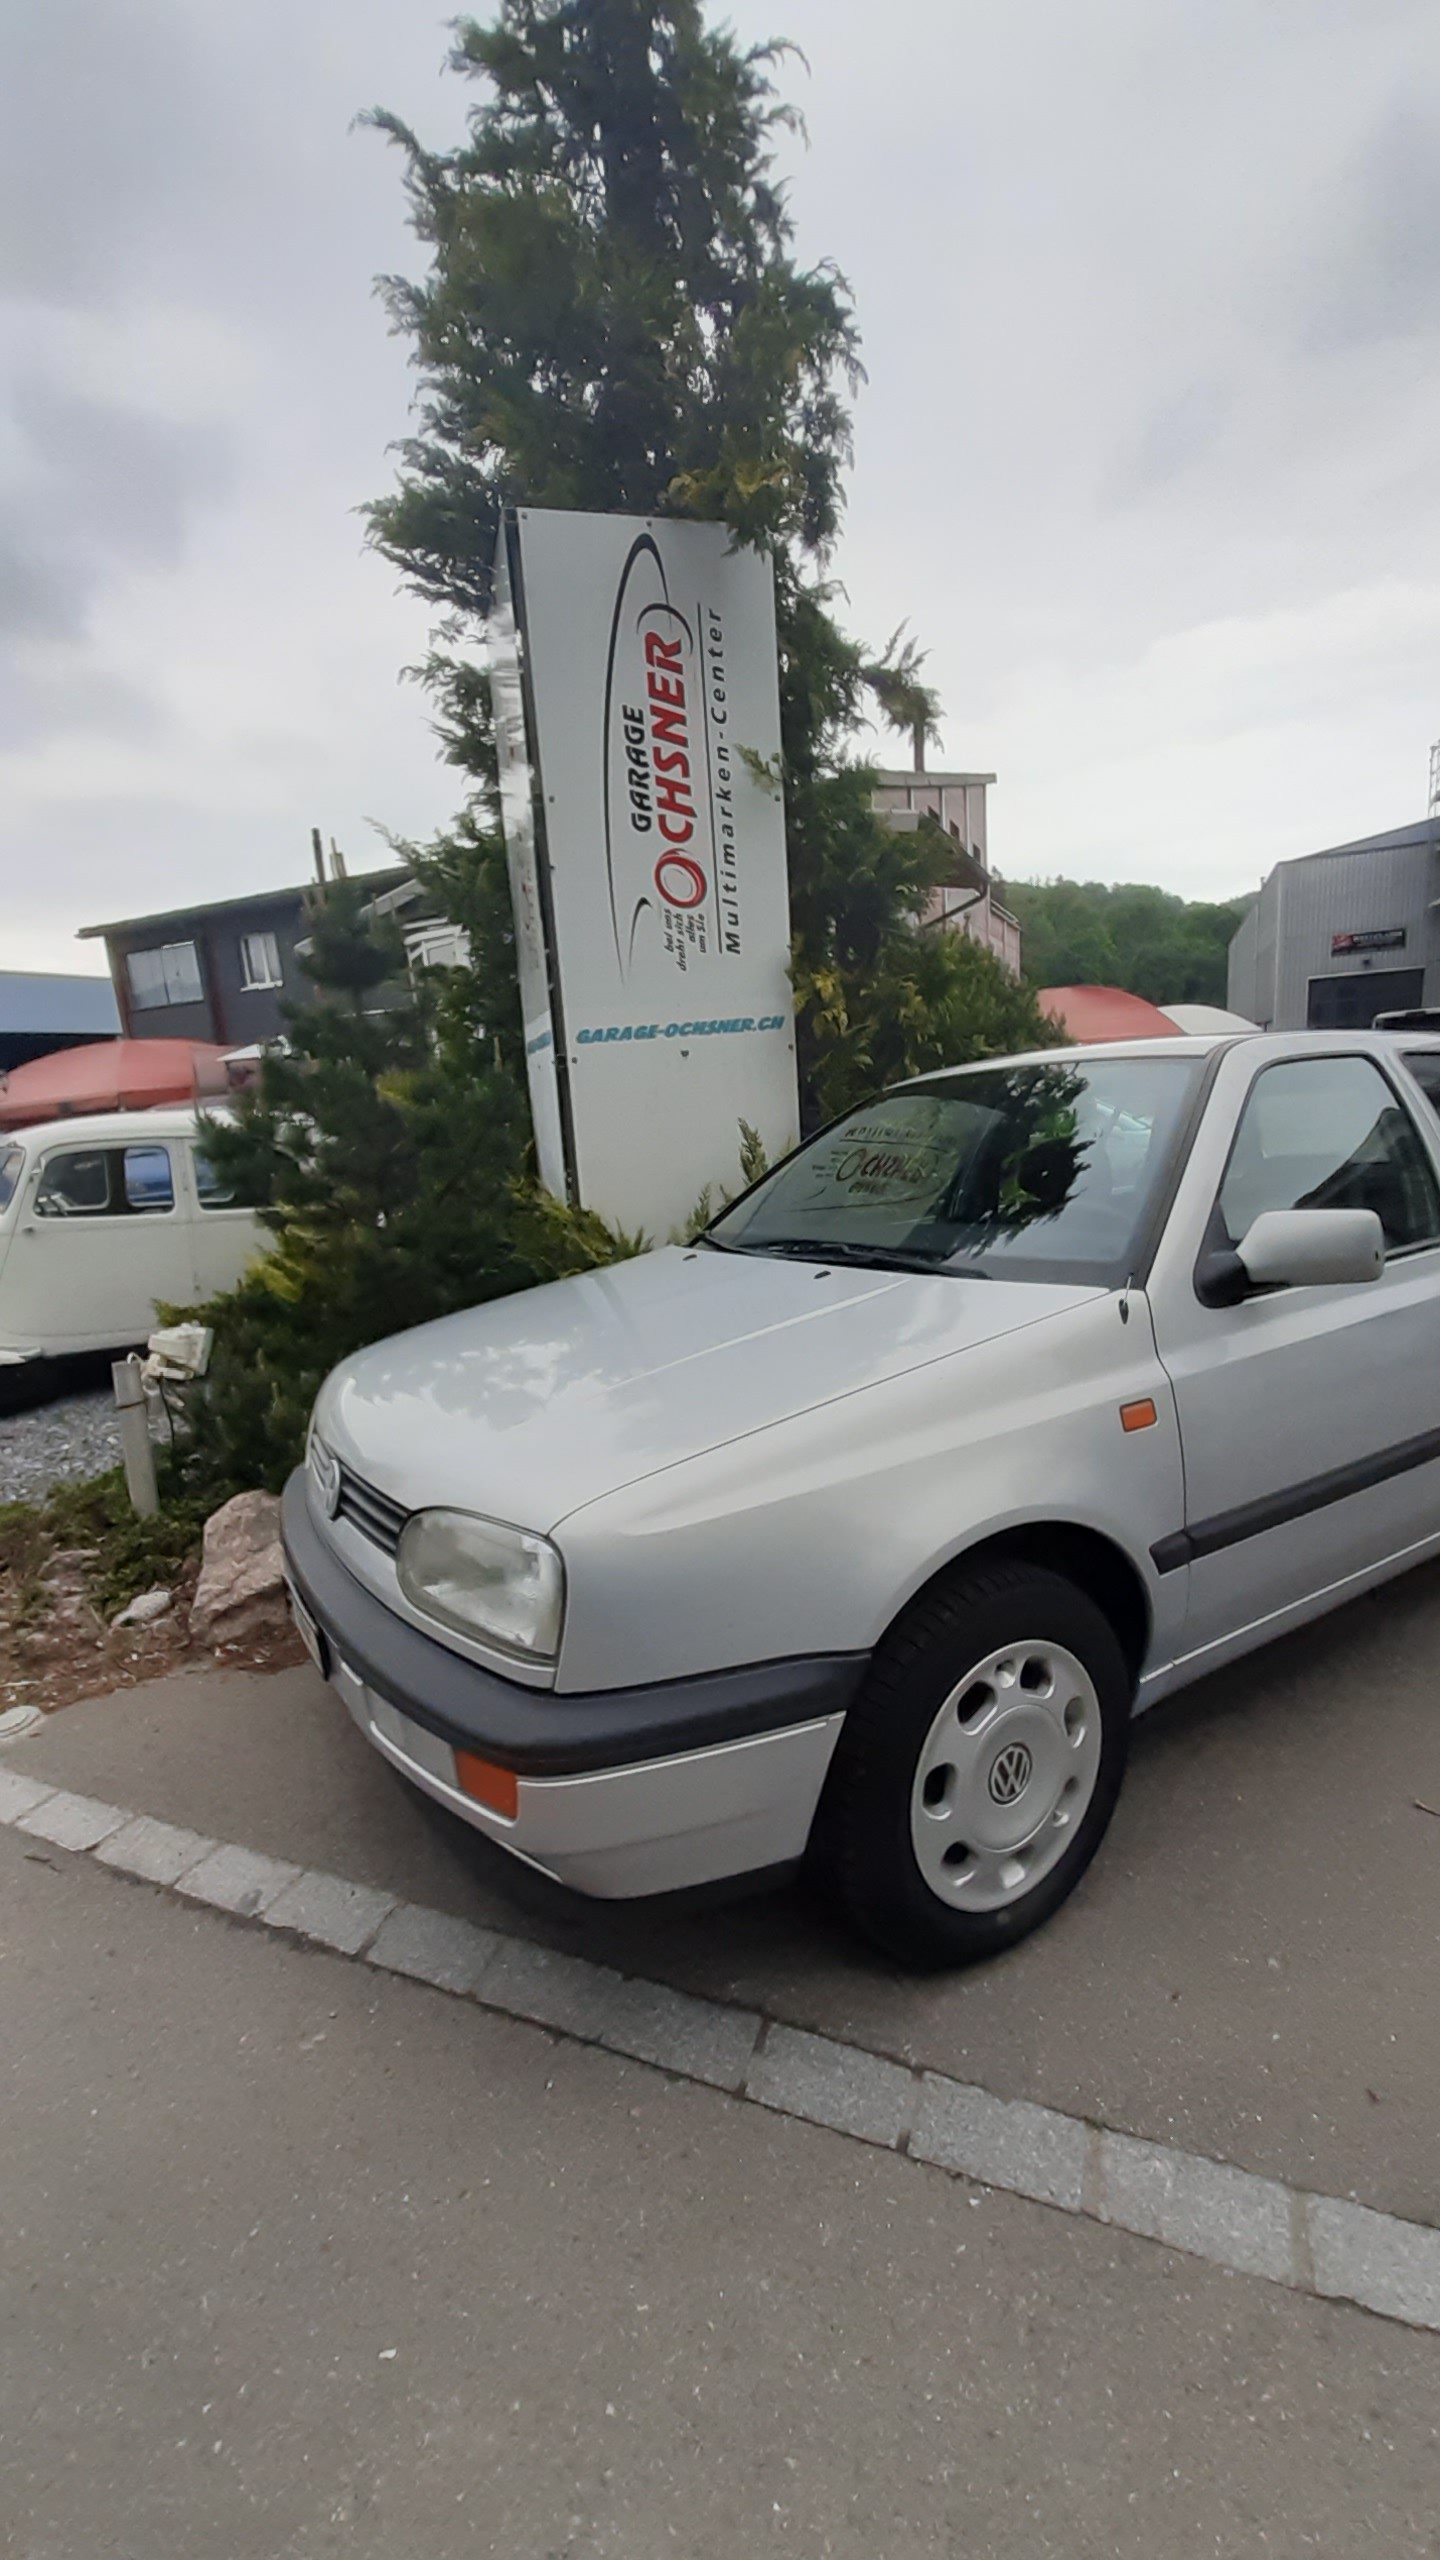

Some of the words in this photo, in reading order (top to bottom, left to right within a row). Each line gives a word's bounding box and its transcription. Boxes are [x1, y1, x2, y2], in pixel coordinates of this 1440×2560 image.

[622, 704, 651, 832] GARAGE
[644, 631, 708, 909] OCHSNER
[708, 608, 741, 955] Multimarken-Center
[675, 938, 687, 972] dreht
[576, 1015, 785, 1044] GARAGE-OCHSNER.CH
